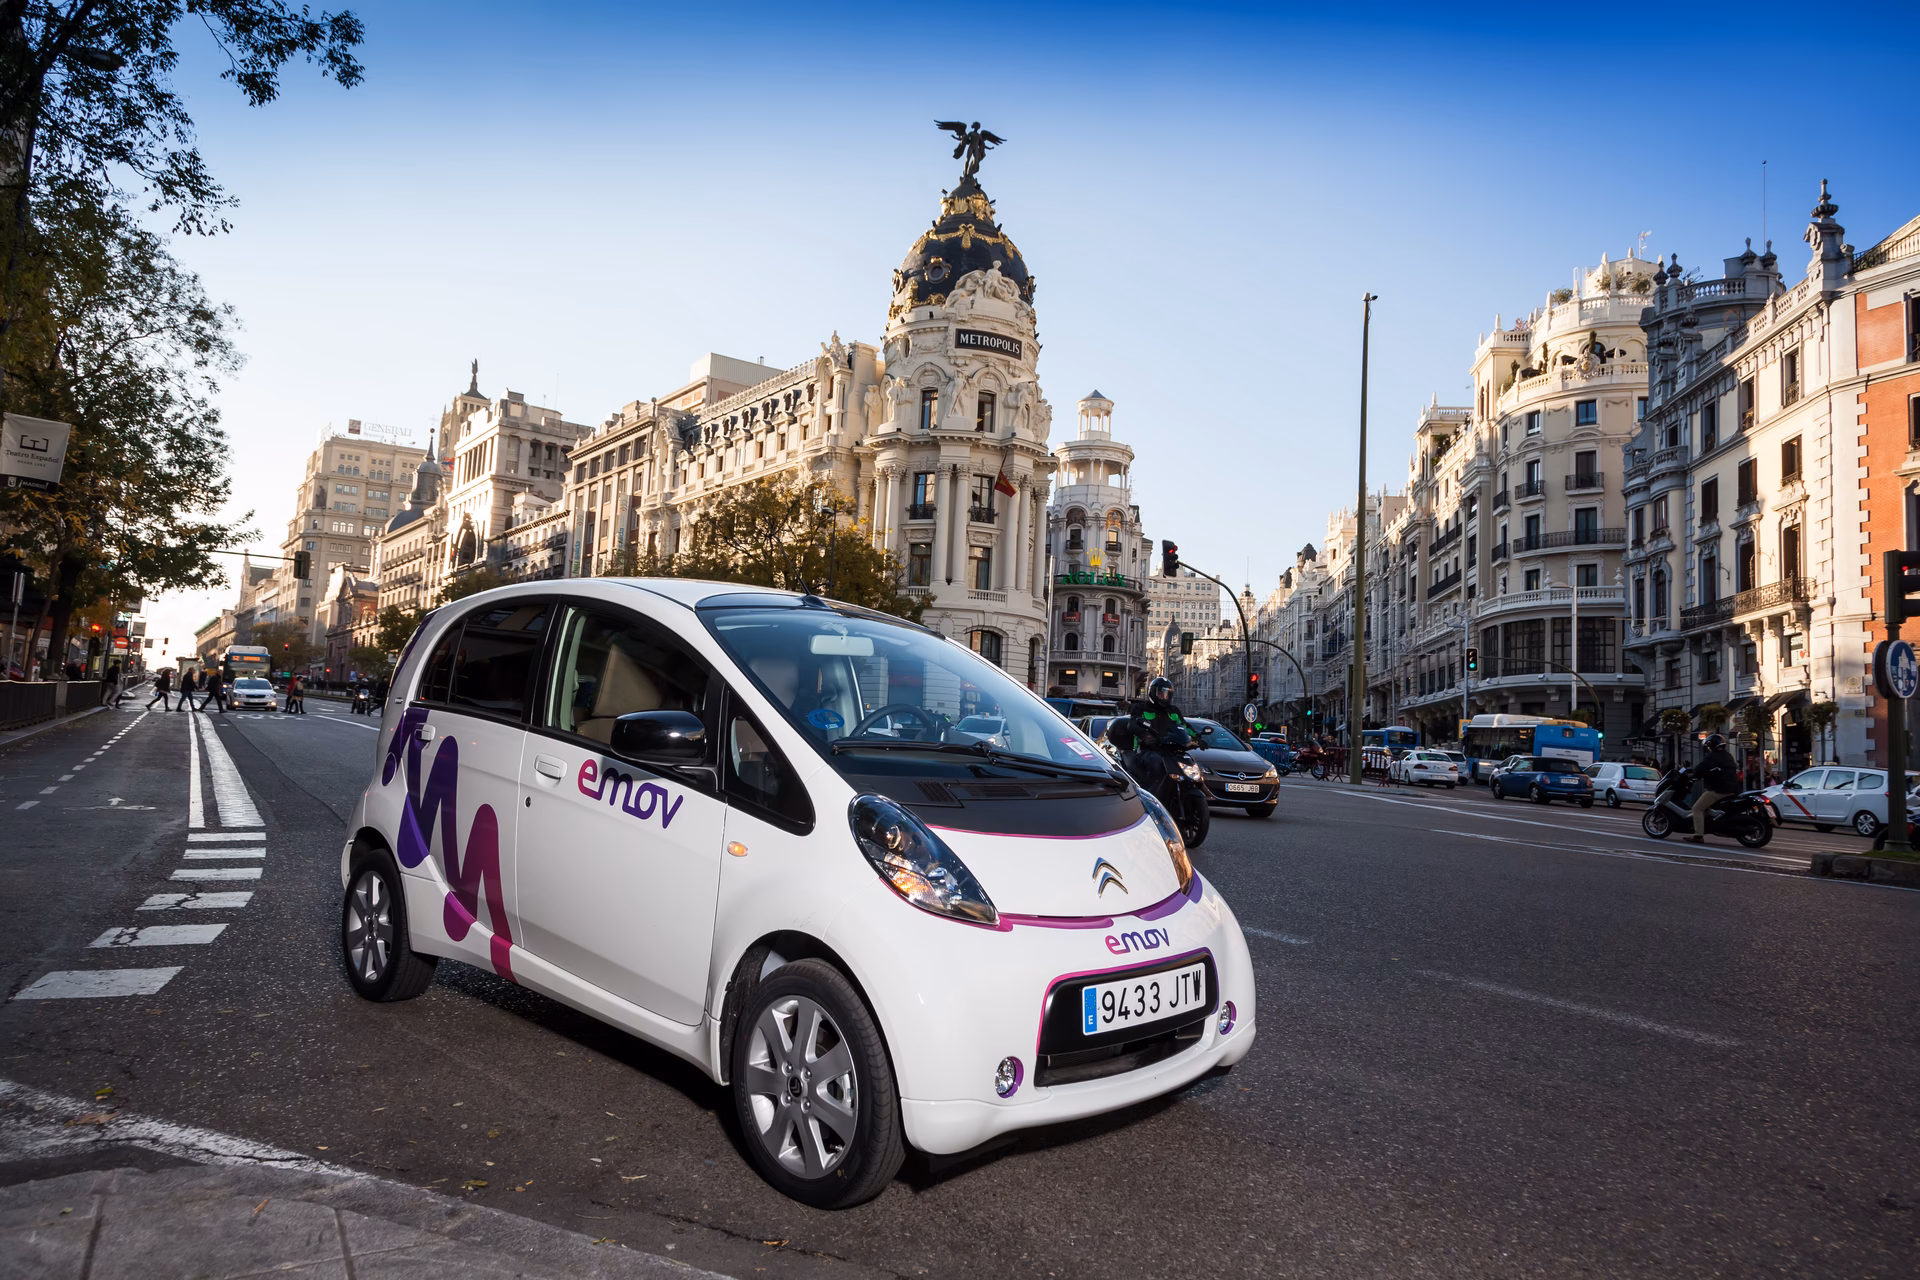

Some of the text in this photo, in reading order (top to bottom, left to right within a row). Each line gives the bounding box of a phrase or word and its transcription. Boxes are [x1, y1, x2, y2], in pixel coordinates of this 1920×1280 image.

[959, 333, 1020, 354] METROPOLIS
[364, 422, 412, 437] GENERALI
[6, 449, 59, 464] Teatro Español
[1062, 570, 1127, 588] ROLEX
[578, 758, 684, 829] emov
[1105, 927, 1170, 955] emov
[1088, 970, 1202, 1025] E 9433 JTW
